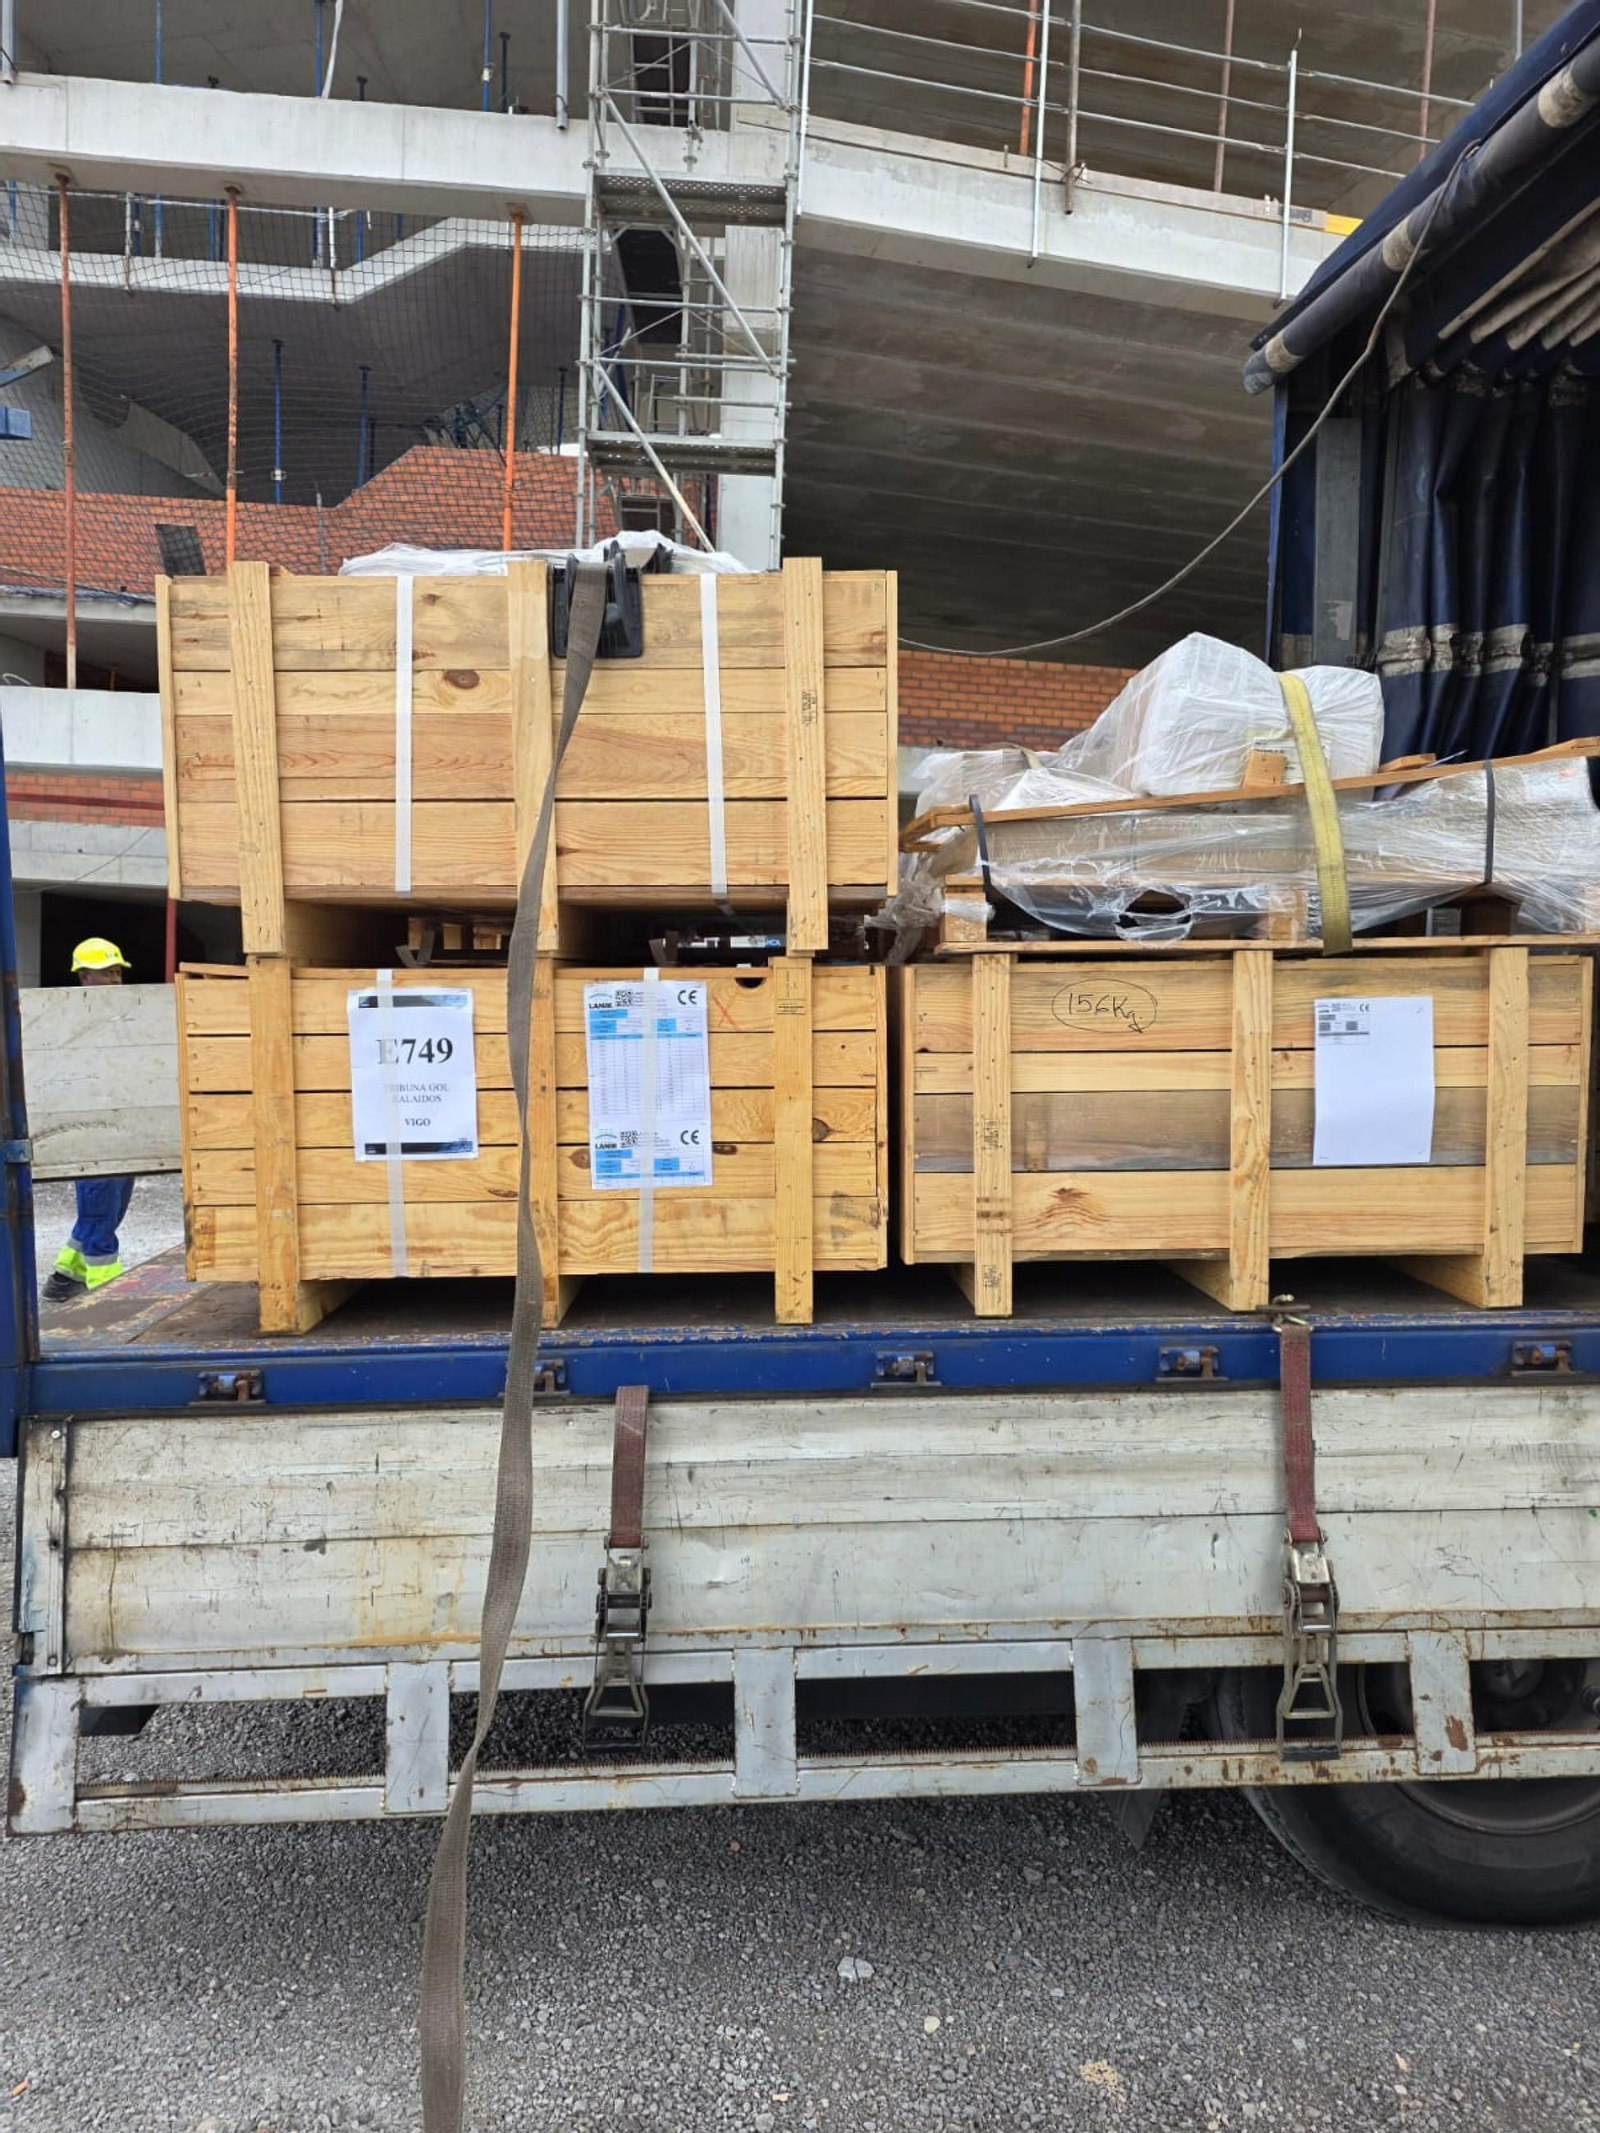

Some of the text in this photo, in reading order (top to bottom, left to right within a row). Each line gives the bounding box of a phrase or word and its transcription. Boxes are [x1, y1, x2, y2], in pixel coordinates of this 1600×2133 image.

[375, 1037, 453, 1065] E749
[428, 1082, 450, 1092] GOL
[404, 1117, 431, 1127] VIGO
